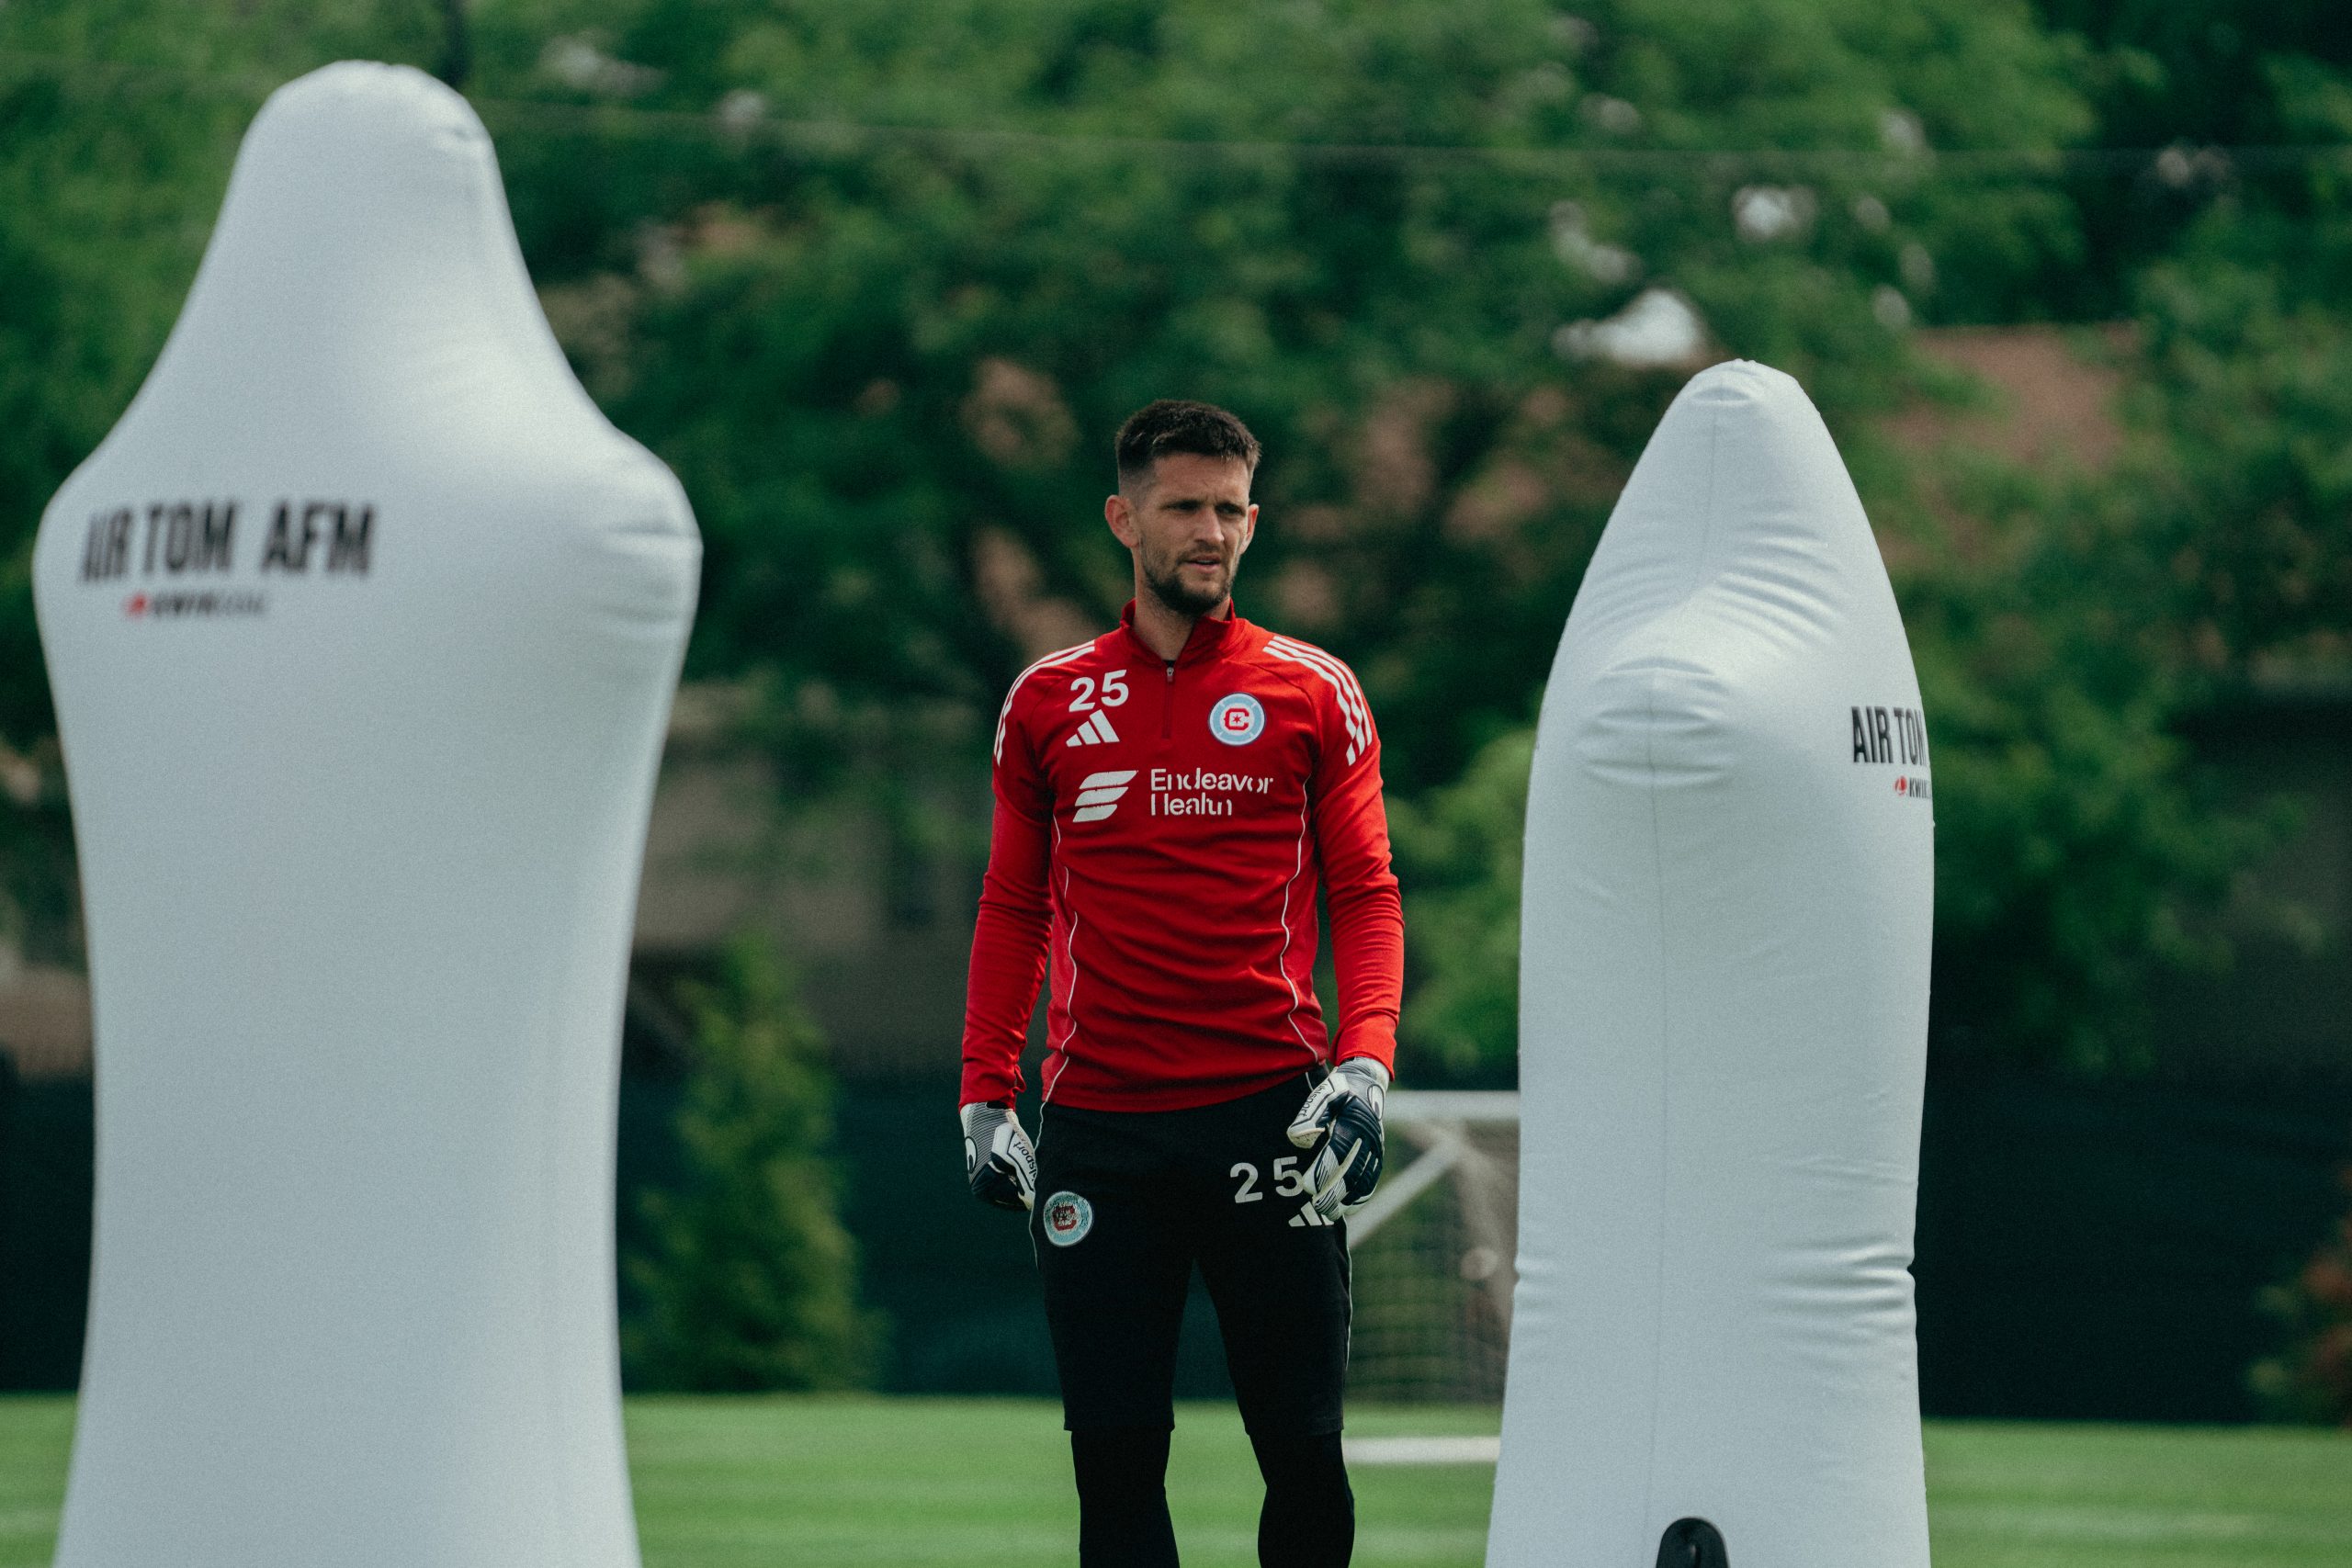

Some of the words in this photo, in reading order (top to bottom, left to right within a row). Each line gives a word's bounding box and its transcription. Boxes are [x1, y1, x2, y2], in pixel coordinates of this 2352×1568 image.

[141, 502, 235, 574] TOM
[260, 501, 373, 574] AFM
[1069, 669, 1129, 712] 25
[1851, 705, 1894, 763] AIR
[1150, 767, 1273, 795] Endeavor
[1229, 1156, 1304, 1203] 25
